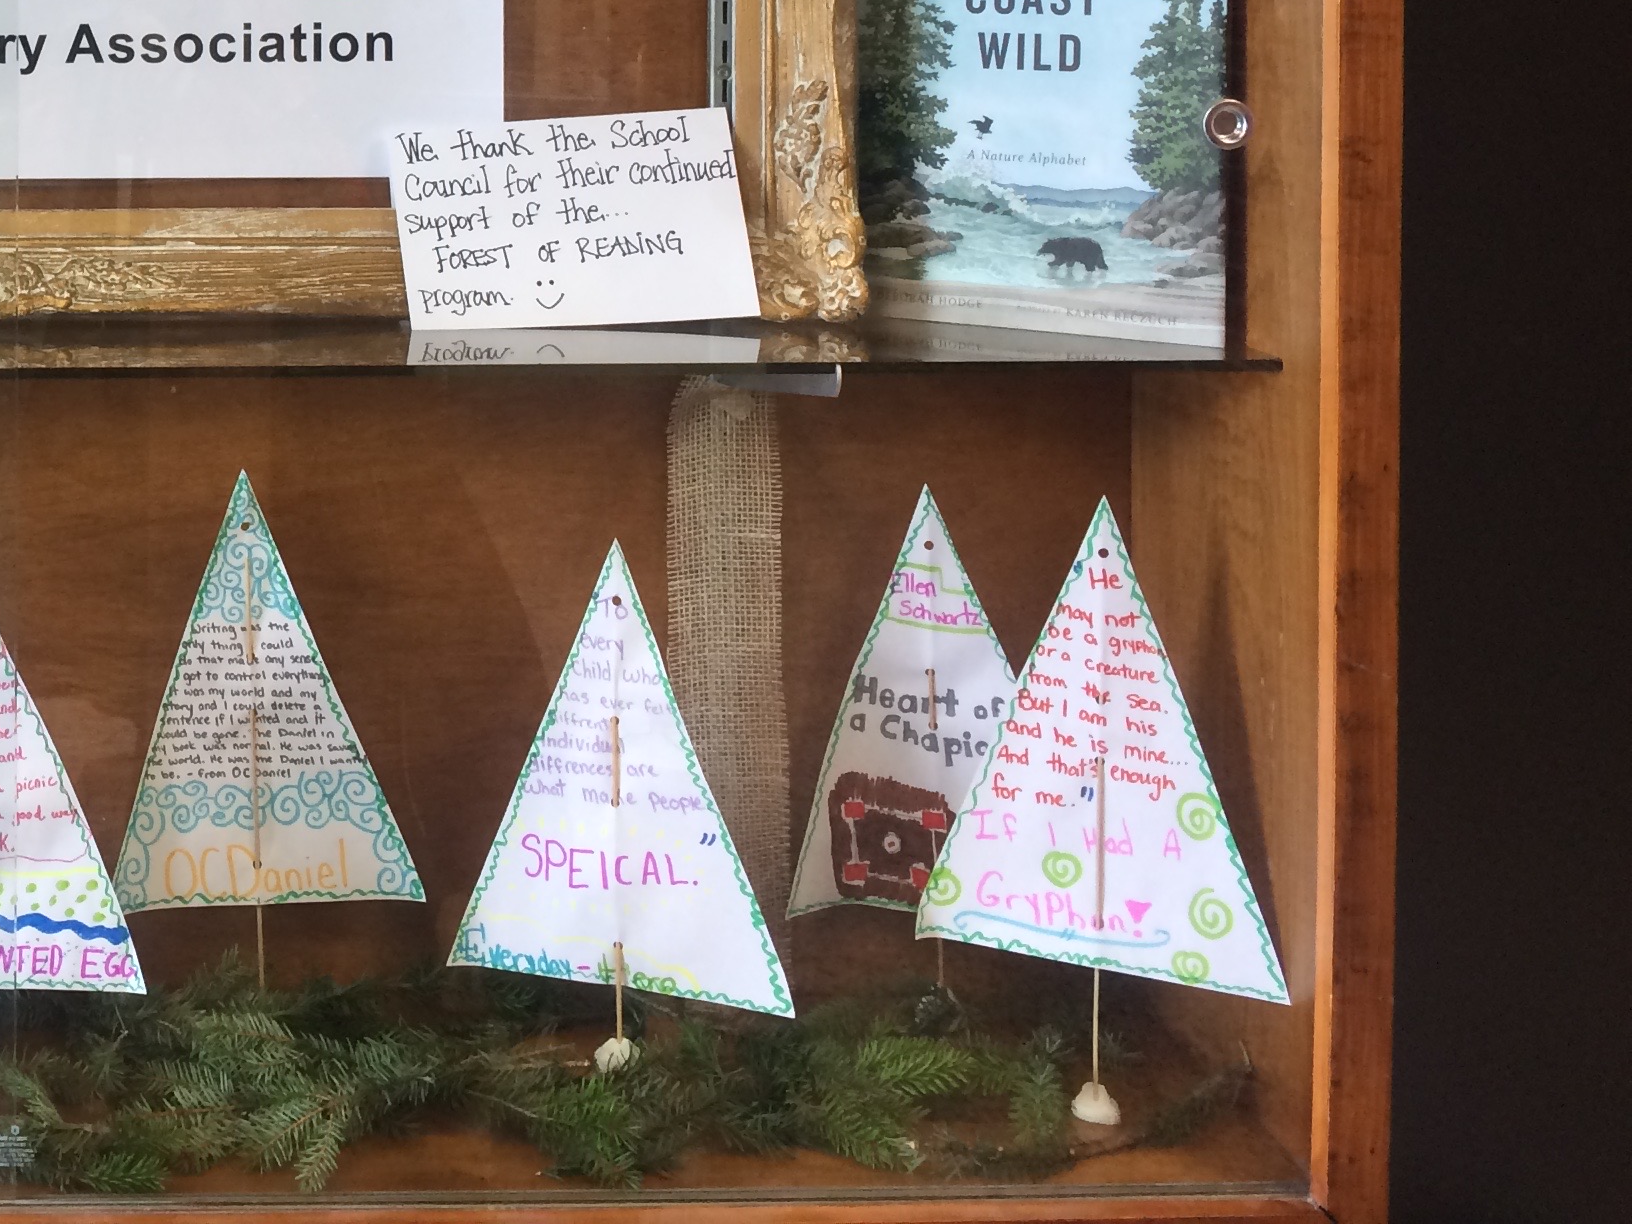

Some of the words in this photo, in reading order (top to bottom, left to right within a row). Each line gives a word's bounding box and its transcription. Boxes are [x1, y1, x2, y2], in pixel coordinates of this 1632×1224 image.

[65, 22, 396, 65] Association
[978, 32, 1082, 73] WILD
[395, 131, 439, 165] We
[449, 127, 534, 162] thank
[546, 123, 596, 156] the
[610, 116, 691, 149] School
[967, 149, 976, 160] A
[980, 149, 1024, 164] Nature
[1028, 152, 1088, 167] Alphabet
[404, 164, 492, 202] Council
[503, 163, 543, 198] for
[555, 157, 620, 191] their
[628, 148, 736, 186] continued
[403, 205, 493, 241] support
[512, 201, 541, 228] of
[432, 243, 513, 273] FOREST
[538, 240, 561, 264] OF
[575, 230, 685, 264] READING
[1104, 612, 1141, 628] not
[853, 673, 960, 718] Heart
[973, 696, 1006, 720] of
[849, 713, 866, 733] a
[1006, 719, 1042, 739] and
[1054, 727, 1077, 748] he
[1088, 734, 1109, 755] is
[1125, 716, 1158, 737] his
[992, 772, 1023, 802] for
[997, 744, 1029, 766] And
[1110, 764, 1177, 802] enough
[970, 809, 1018, 843] If
[1162, 828, 1183, 861] A
[165, 837, 349, 899] OCDaniel
